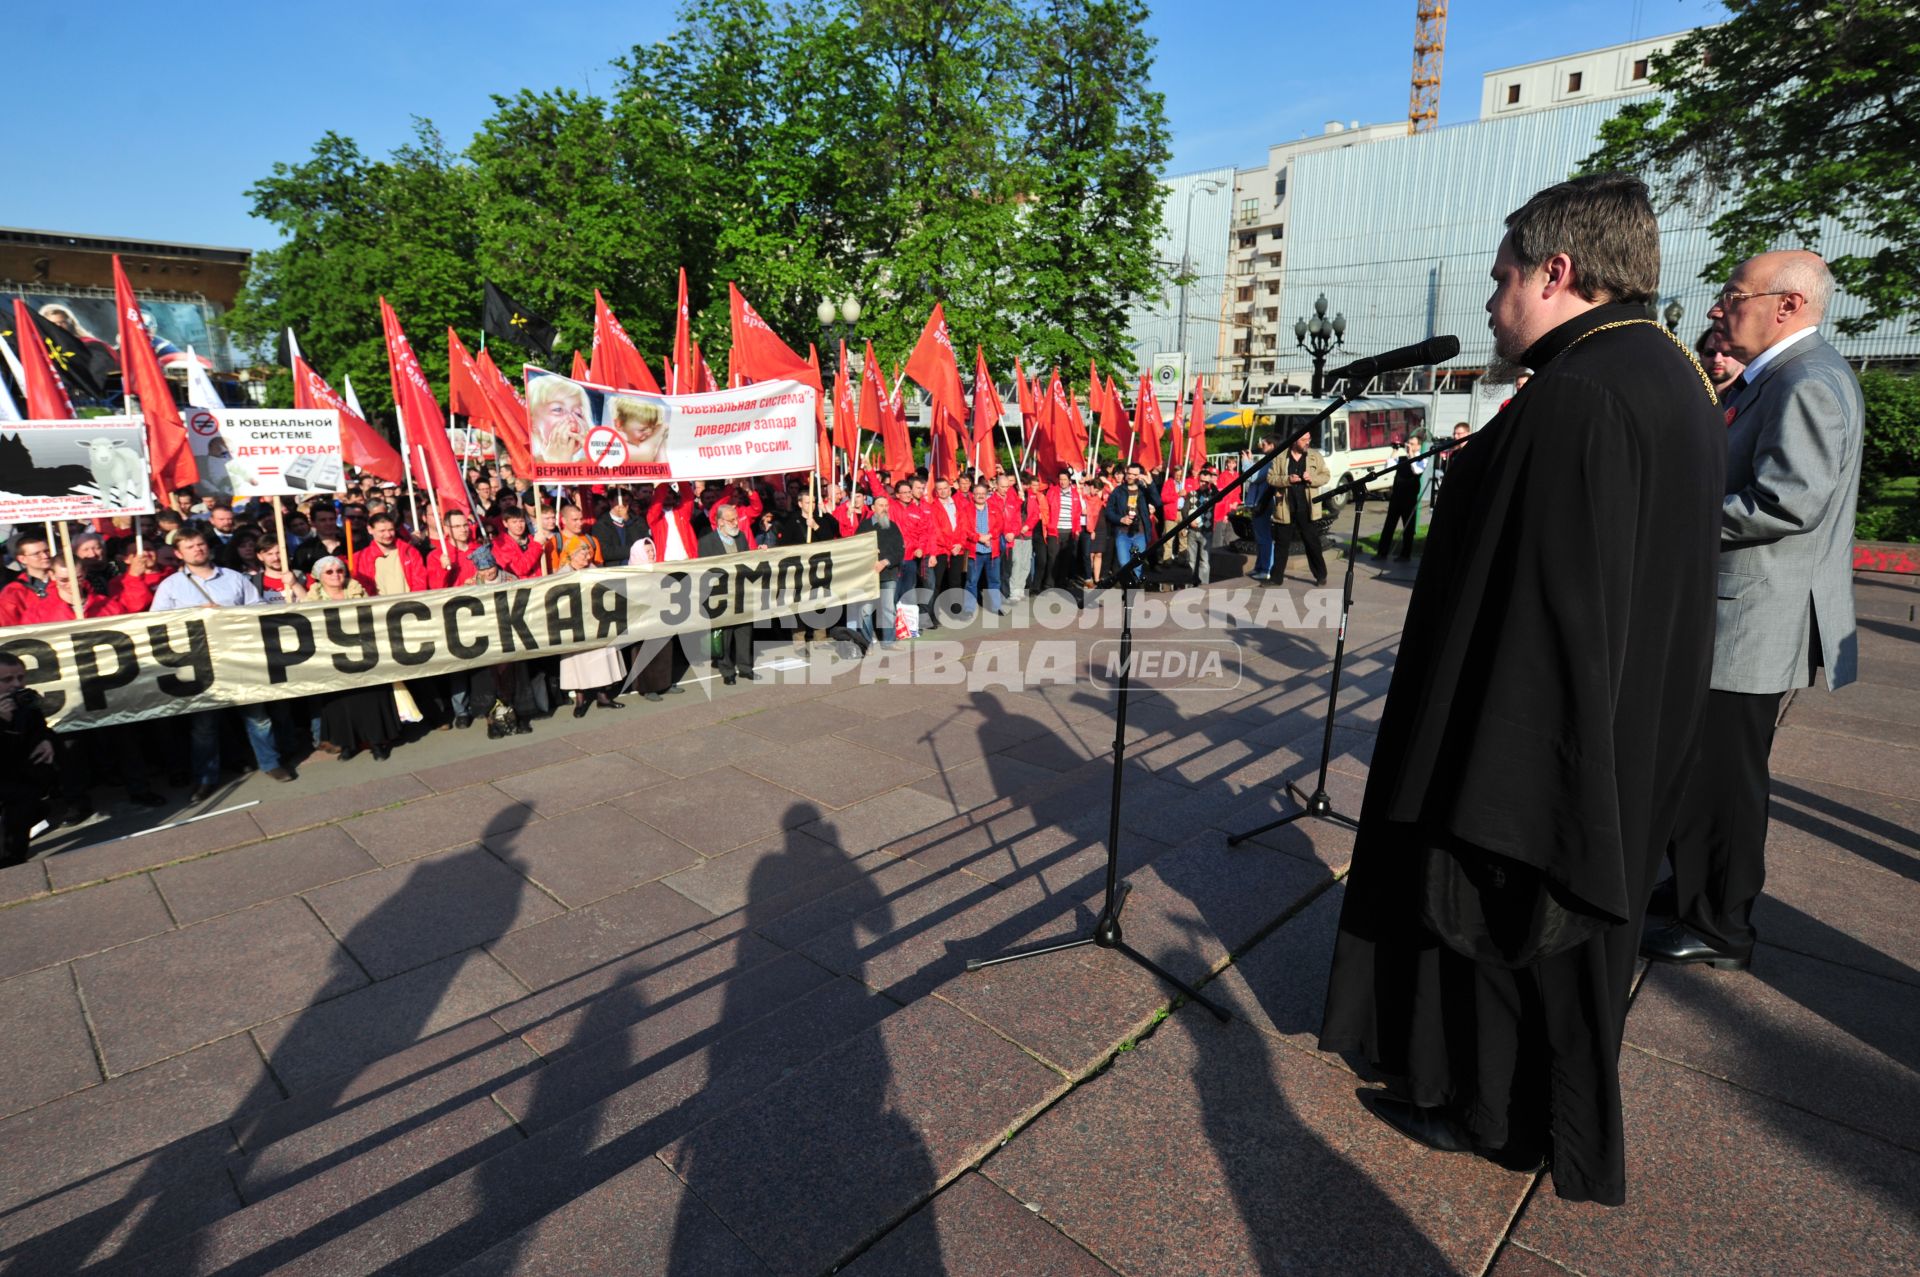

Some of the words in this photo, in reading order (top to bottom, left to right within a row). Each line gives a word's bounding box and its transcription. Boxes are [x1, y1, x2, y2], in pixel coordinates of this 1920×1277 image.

[226, 419, 235, 427] В
[239, 417, 333, 427] ЮВЕНАЛЬНОЙ
[694, 421, 751, 437] диверсия
[753, 416, 797, 430] запада
[251, 431, 313, 439] СИСТЕМЕ
[237, 444, 340, 457] ДЕТИ-ТОВАР!
[698, 443, 743, 459] против
[745, 440, 792, 454] России.
[536, 465, 584, 477] ВЕРНИТЕ
[586, 465, 609, 476] НАМ
[612, 465, 669, 477] РОДИТЕЛЕЙ!
[41, 495, 94, 505] ЮСТИЦИЯ
[258, 578, 629, 684] РУССКАЯ
